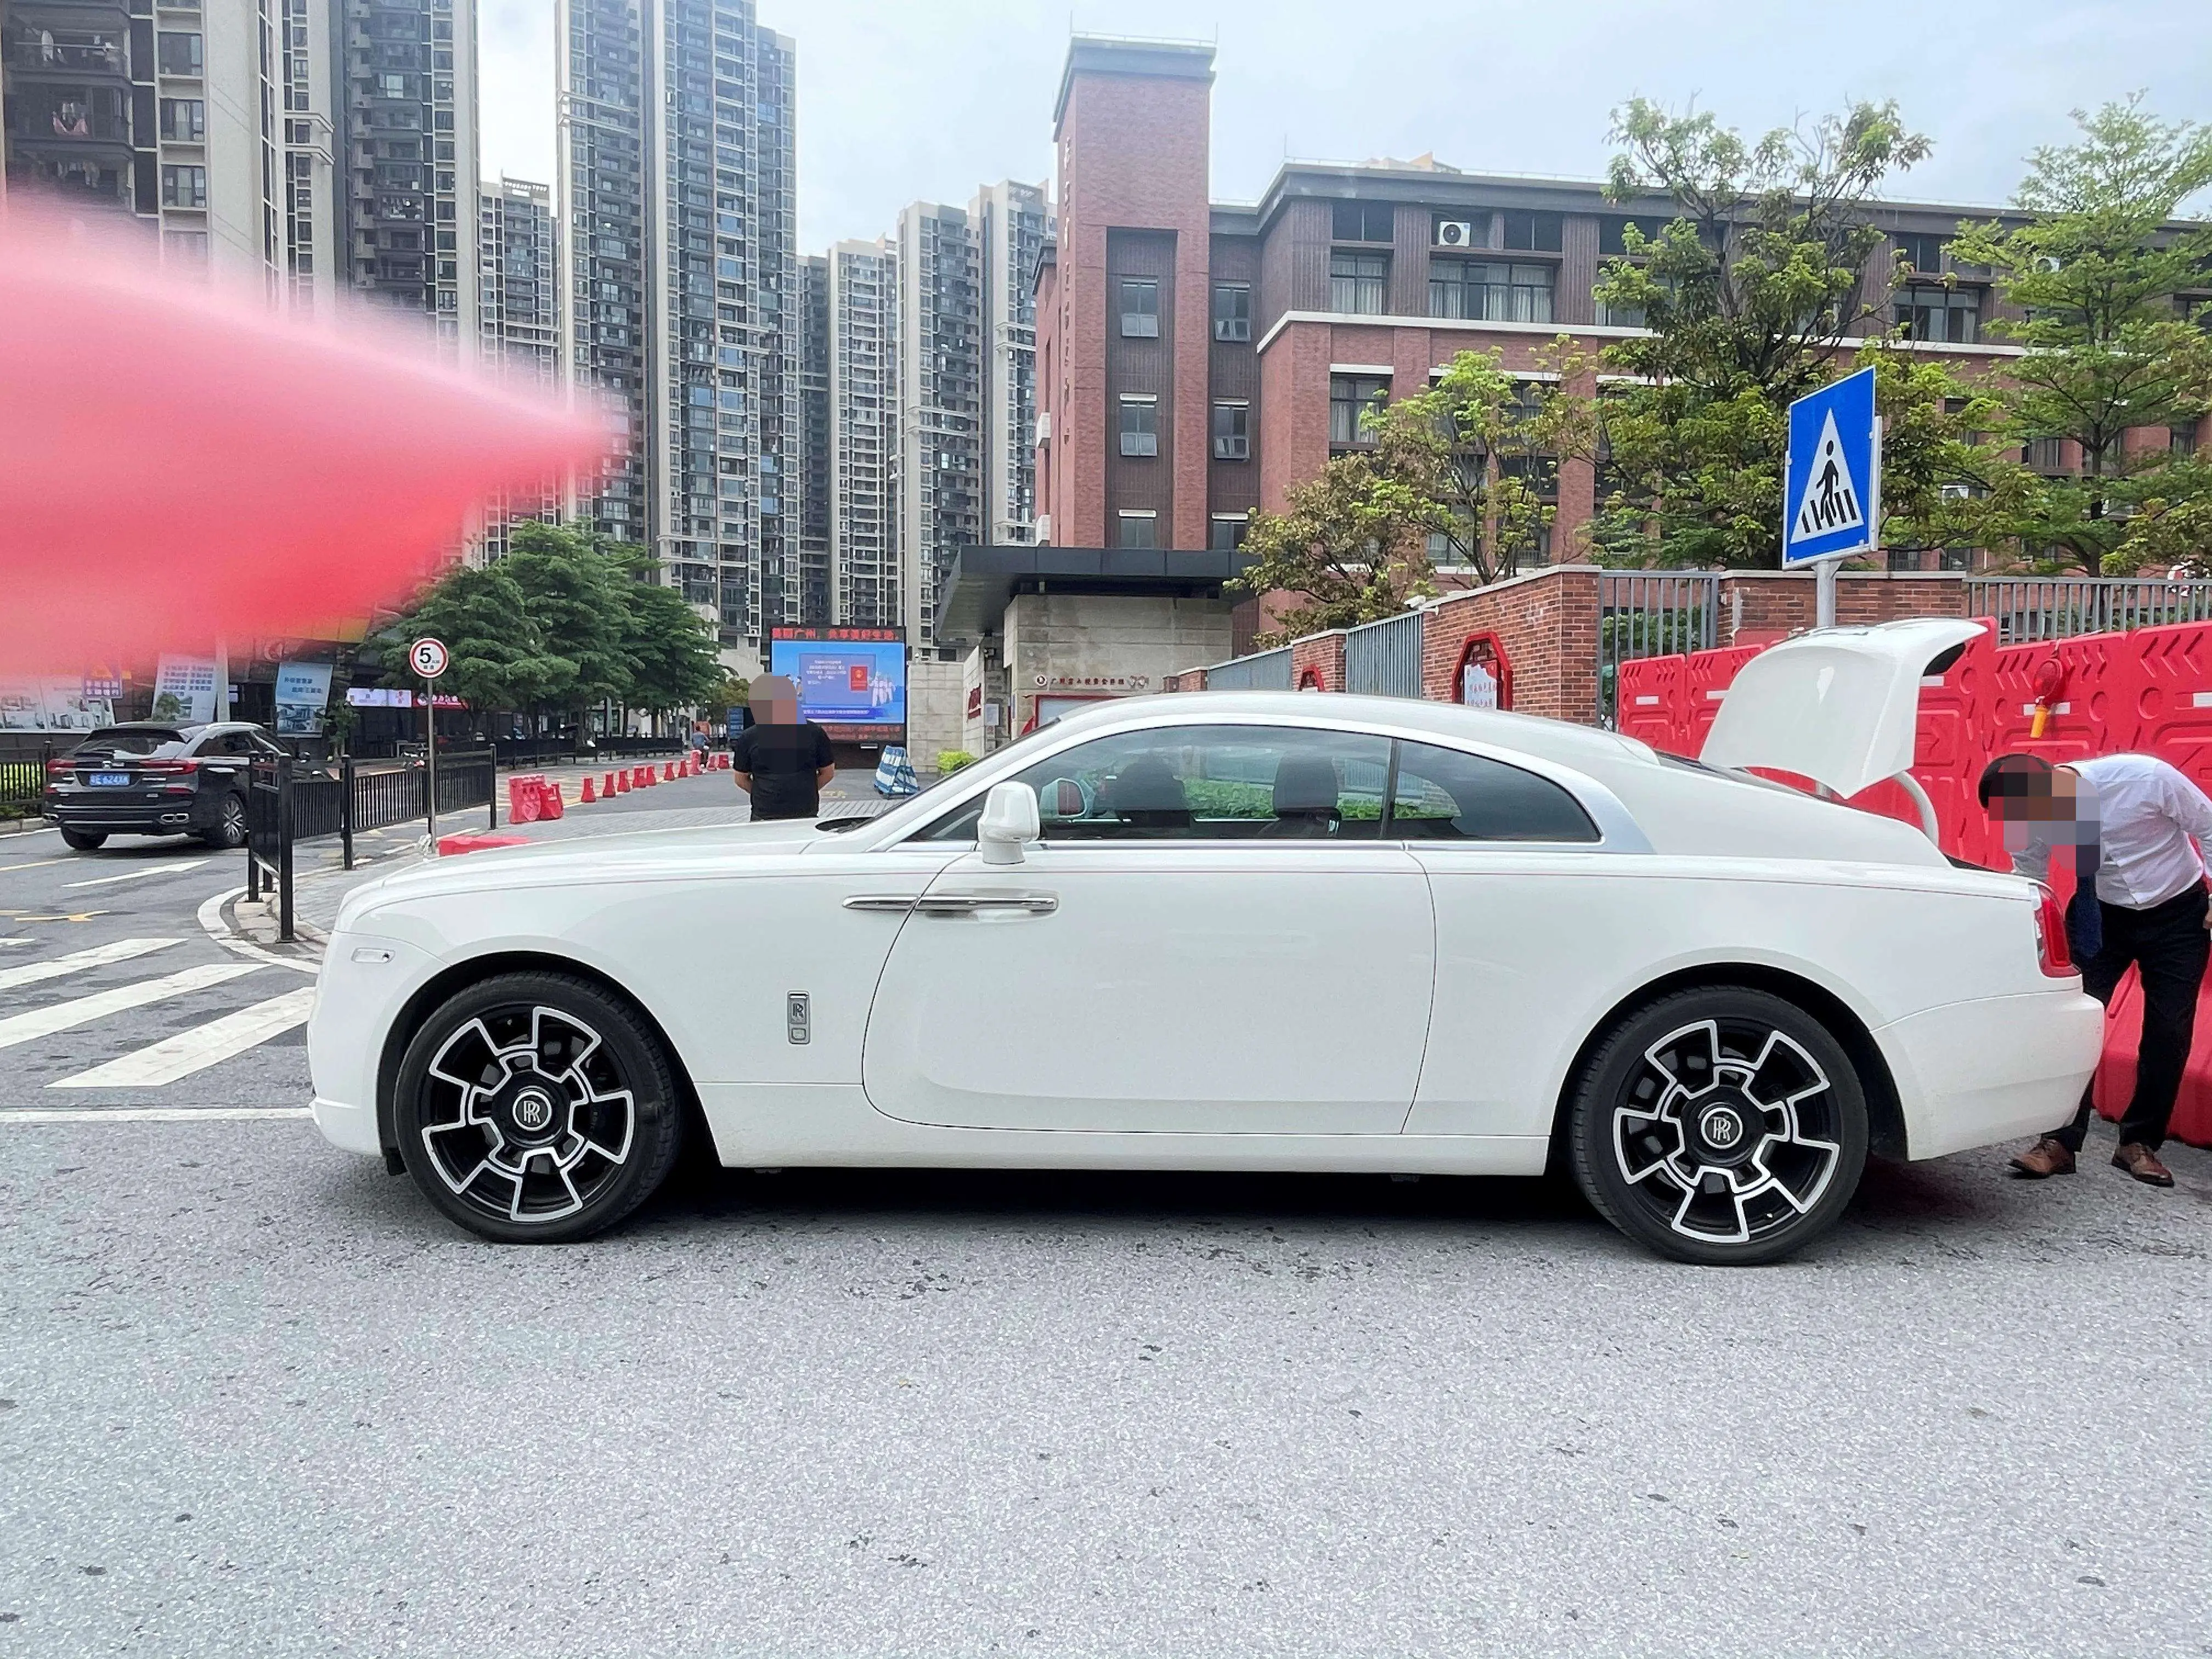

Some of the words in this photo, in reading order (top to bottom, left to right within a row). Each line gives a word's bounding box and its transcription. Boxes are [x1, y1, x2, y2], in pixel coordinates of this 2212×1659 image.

[420, 647, 431, 663] 5
[523, 1101, 540, 1124] RR
[1713, 1116, 1731, 1141] RR
